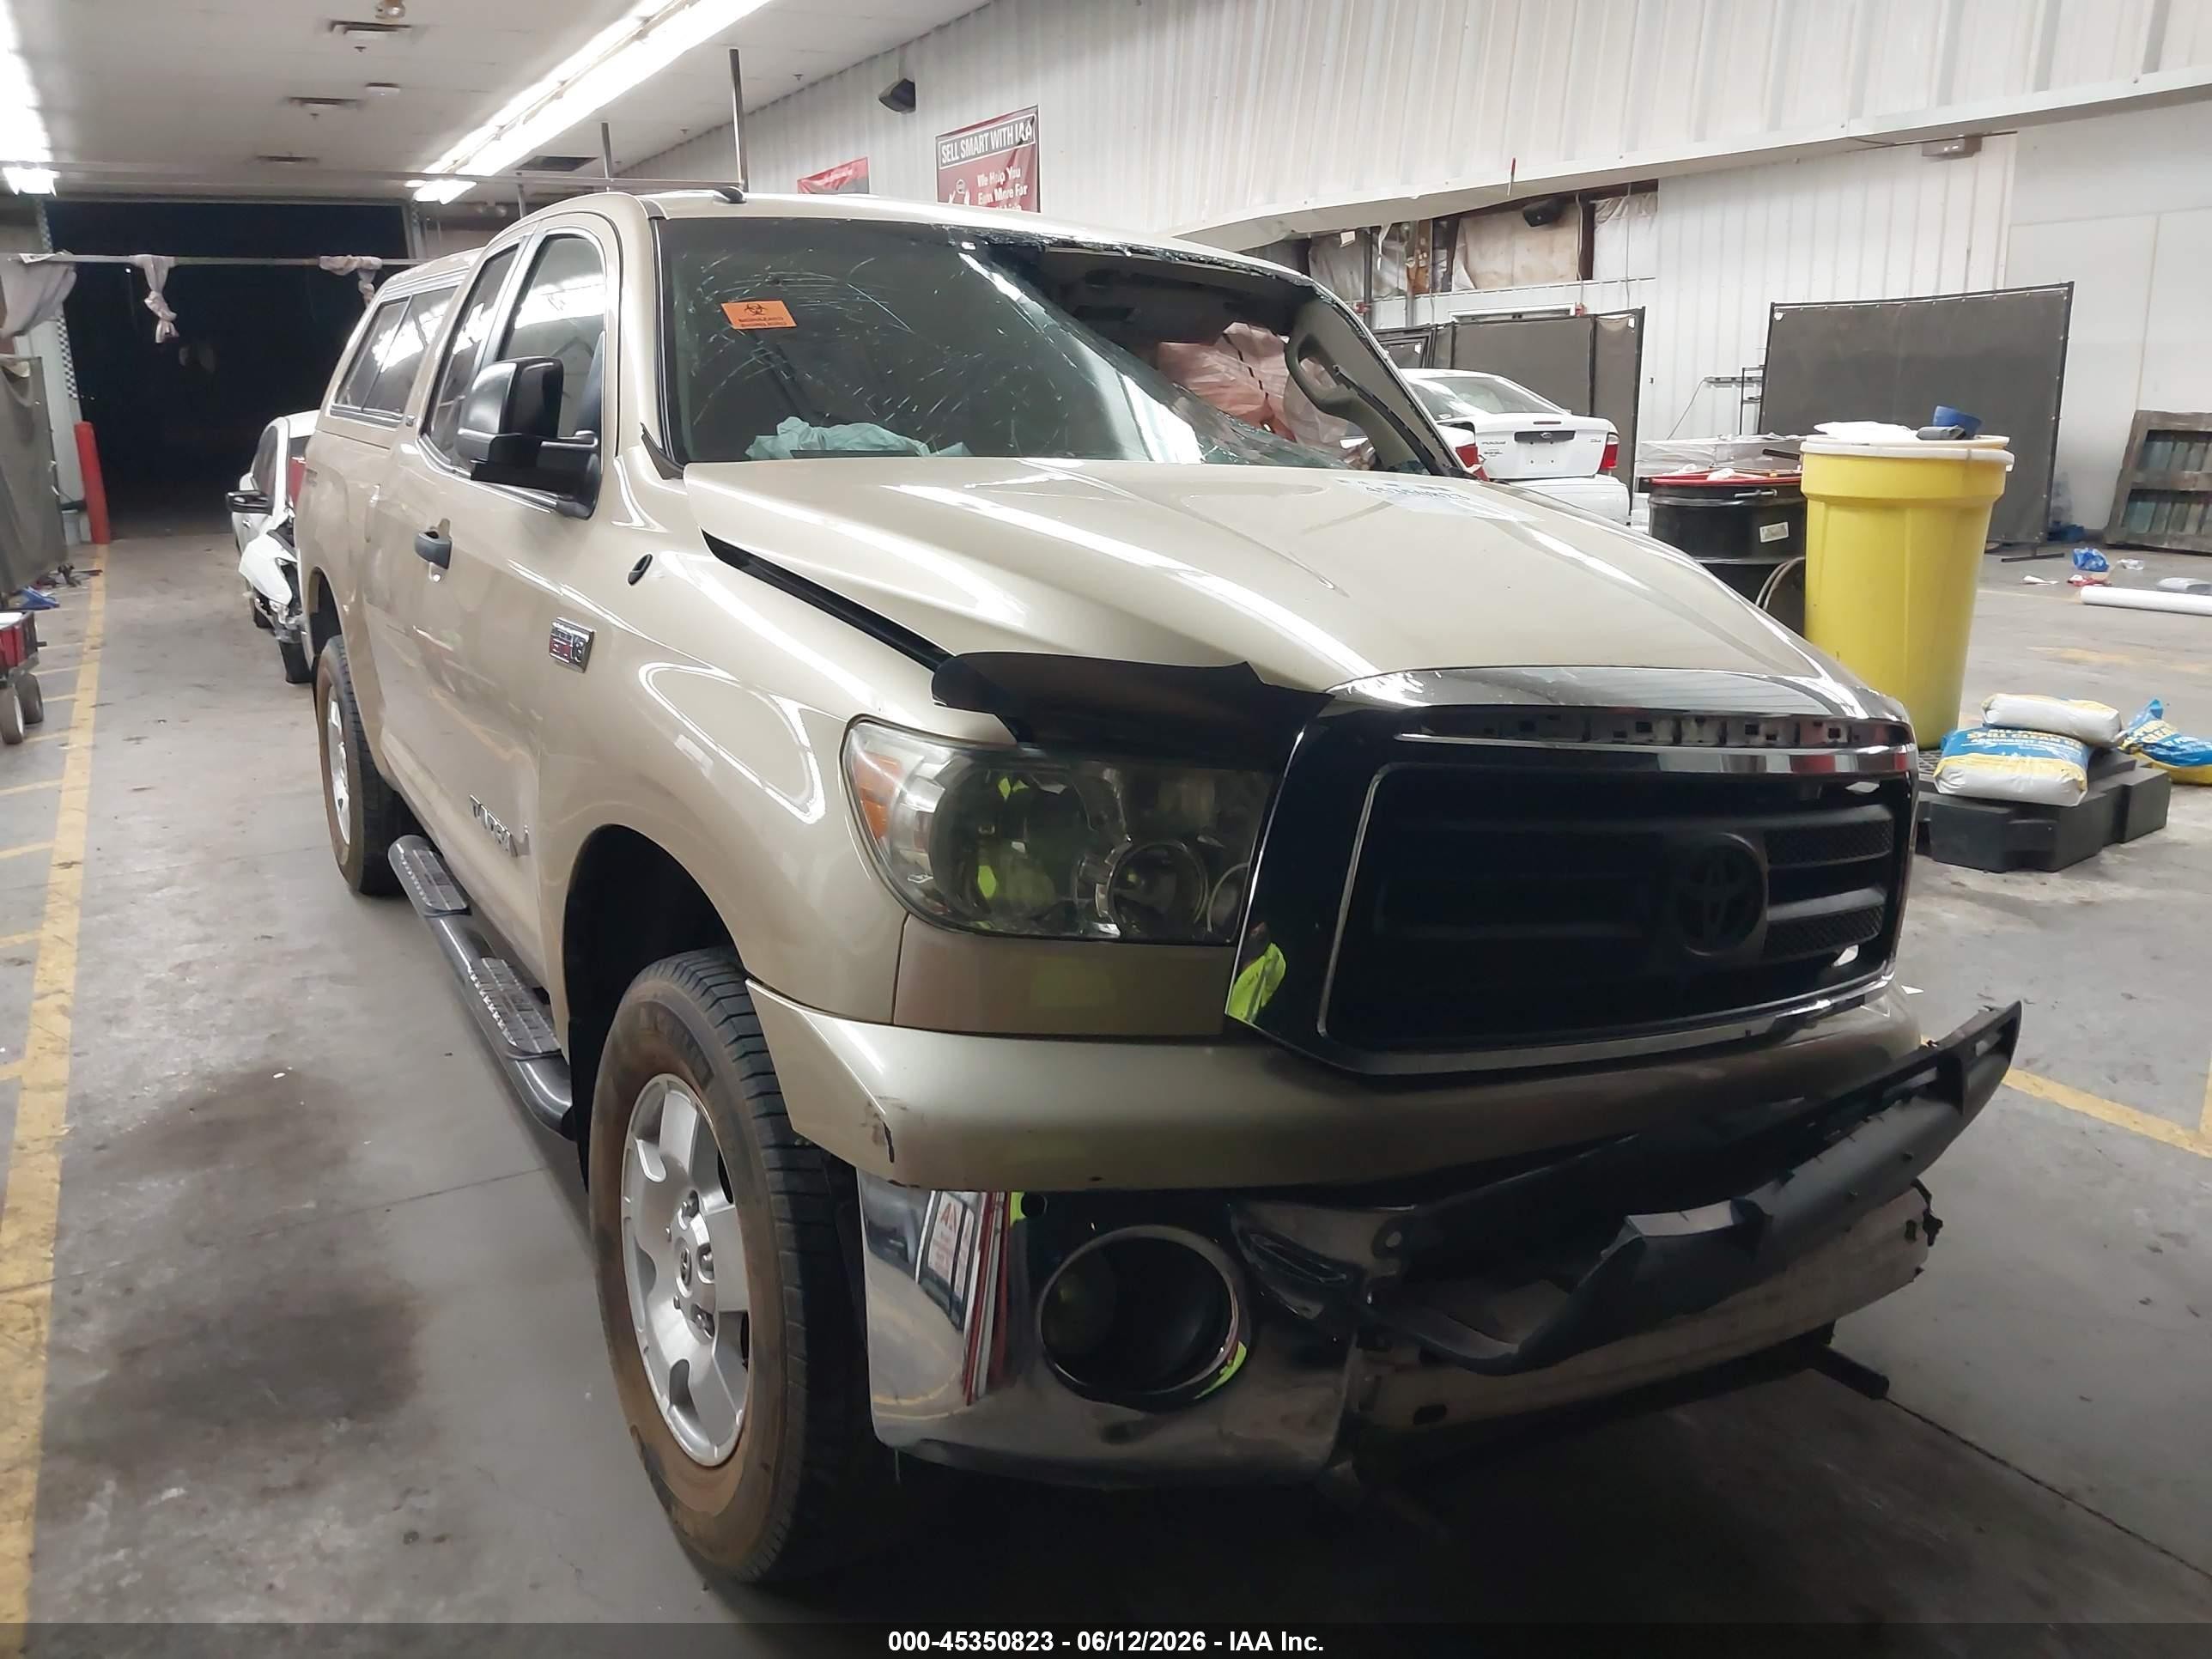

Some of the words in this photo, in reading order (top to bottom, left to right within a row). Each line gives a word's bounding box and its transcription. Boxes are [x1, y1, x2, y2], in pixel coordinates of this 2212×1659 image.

[941, 142, 959, 163] SELL
[960, 132, 989, 158] SMART
[990, 125, 1013, 149] WITH
[1006, 166, 1021, 180] You
[994, 186, 1014, 202] More
[1014, 182, 1029, 198] For
